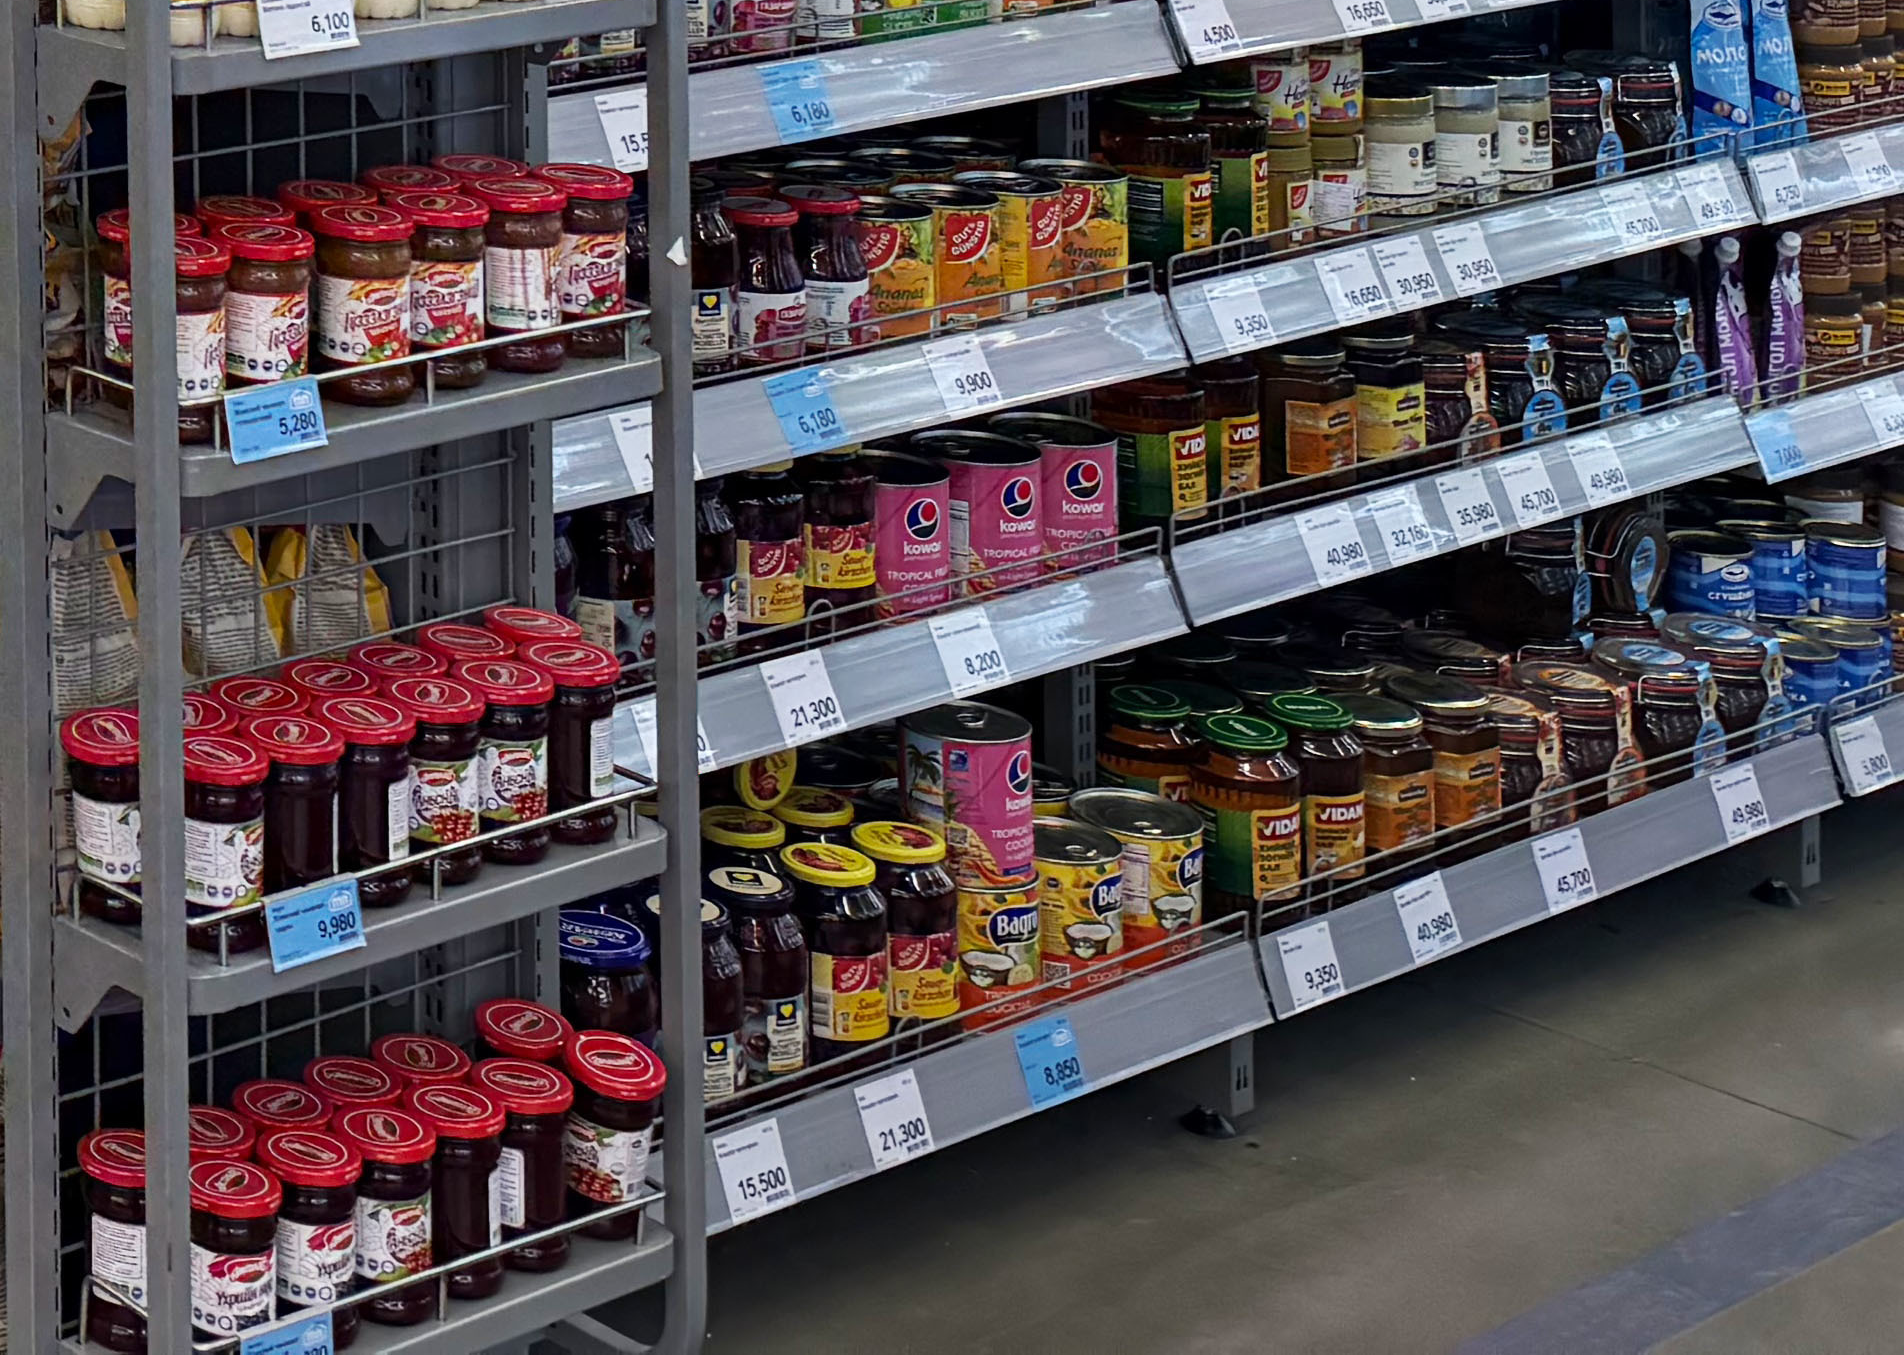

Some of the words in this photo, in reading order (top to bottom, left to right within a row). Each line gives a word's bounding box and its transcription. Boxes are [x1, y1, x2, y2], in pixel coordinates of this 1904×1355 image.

[311, 11, 350, 34] 6,100
[1202, 23, 1235, 44] 4,500
[791, 100, 830, 124] 6,180
[1455, 258, 1494, 281] 30,950
[1396, 271, 1435, 296] 30,950
[955, 372, 992, 396] 9,900
[278, 411, 318, 436] 5,280
[798, 407, 837, 433] 6,180
[1456, 502, 1495, 527] 35,980
[1326, 543, 1364, 566] 40,980
[965, 649, 1002, 675] 8,200
[790, 696, 837, 726] 21,300
[1556, 867, 1591, 894] 45,700
[317, 911, 357, 940] 9,980
[1416, 912, 1453, 942] 40,980
[1304, 963, 1338, 991] 9,350
[1043, 1057, 1082, 1086] 8,850
[880, 1117, 925, 1152] 21,300
[738, 1166, 786, 1200] 15,500
